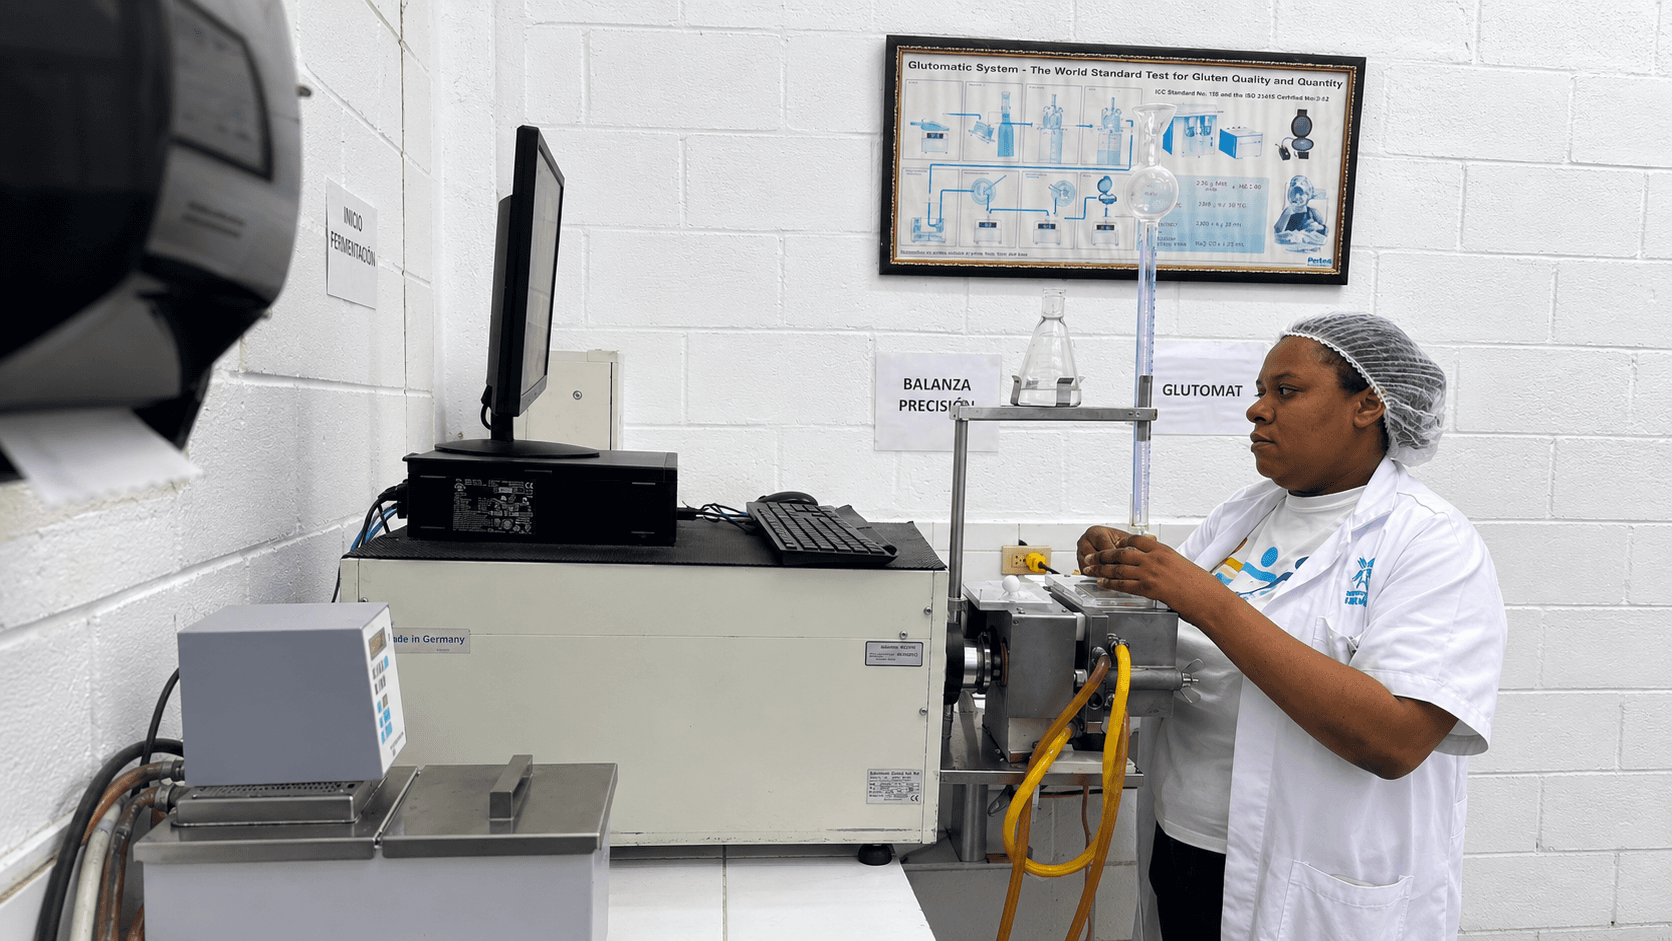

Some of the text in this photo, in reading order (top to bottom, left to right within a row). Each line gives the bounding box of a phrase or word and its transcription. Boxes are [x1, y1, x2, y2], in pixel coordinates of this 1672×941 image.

[908, 60, 972, 72] Glutomatic
[976, 63, 1019, 74] System
[1030, 65, 1051, 75] The
[1054, 66, 1087, 77] World
[1091, 68, 1142, 79] Standard
[1145, 70, 1170, 80] Test
[1172, 71, 1189, 81] for
[1192, 72, 1228, 83] Gluten
[1231, 74, 1271, 87] Quality
[1273, 77, 1294, 86] and
[1297, 77, 1343, 89] Quantity
[343, 206, 363, 232] INICIO
[330, 230, 376, 267] FERMENTACIÓN
[903, 377, 972, 391] BALANZA
[1162, 383, 1243, 397] GLUTOMAT
[393, 634, 466, 646] ade in Germany
